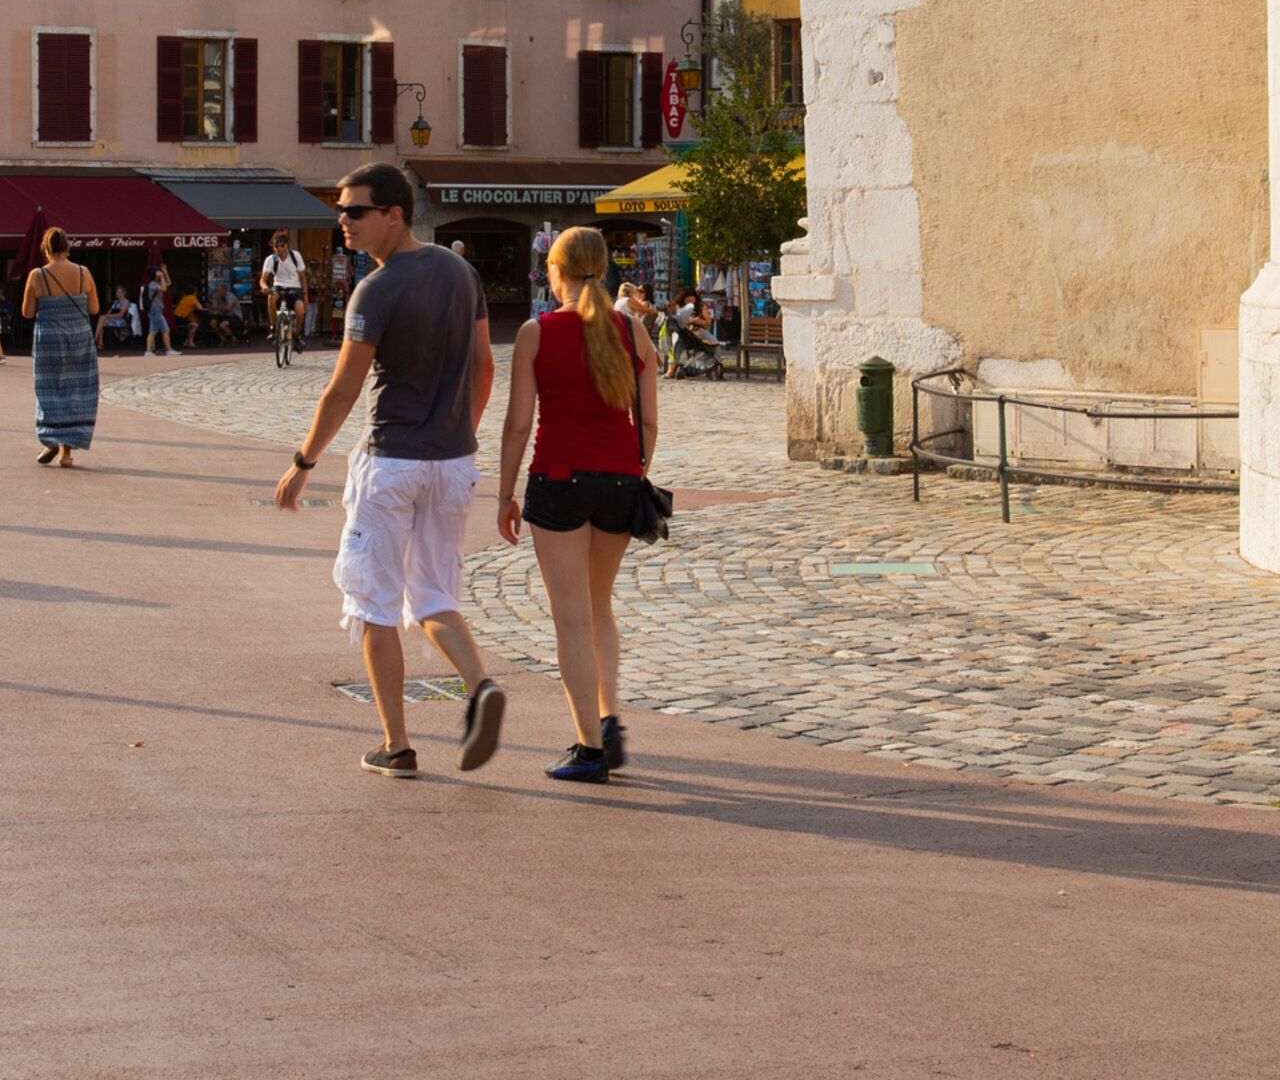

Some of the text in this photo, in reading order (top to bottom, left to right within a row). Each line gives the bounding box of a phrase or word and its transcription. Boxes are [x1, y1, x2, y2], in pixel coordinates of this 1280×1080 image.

[669, 72, 679, 128] TABAC
[440, 189, 458, 203] LE
[462, 189, 562, 204] CHOCOLATIER
[618, 201, 646, 212] LOTO
[85, 237, 104, 247] du
[110, 237, 145, 247] Thiou
[173, 236, 219, 248] GLACES
